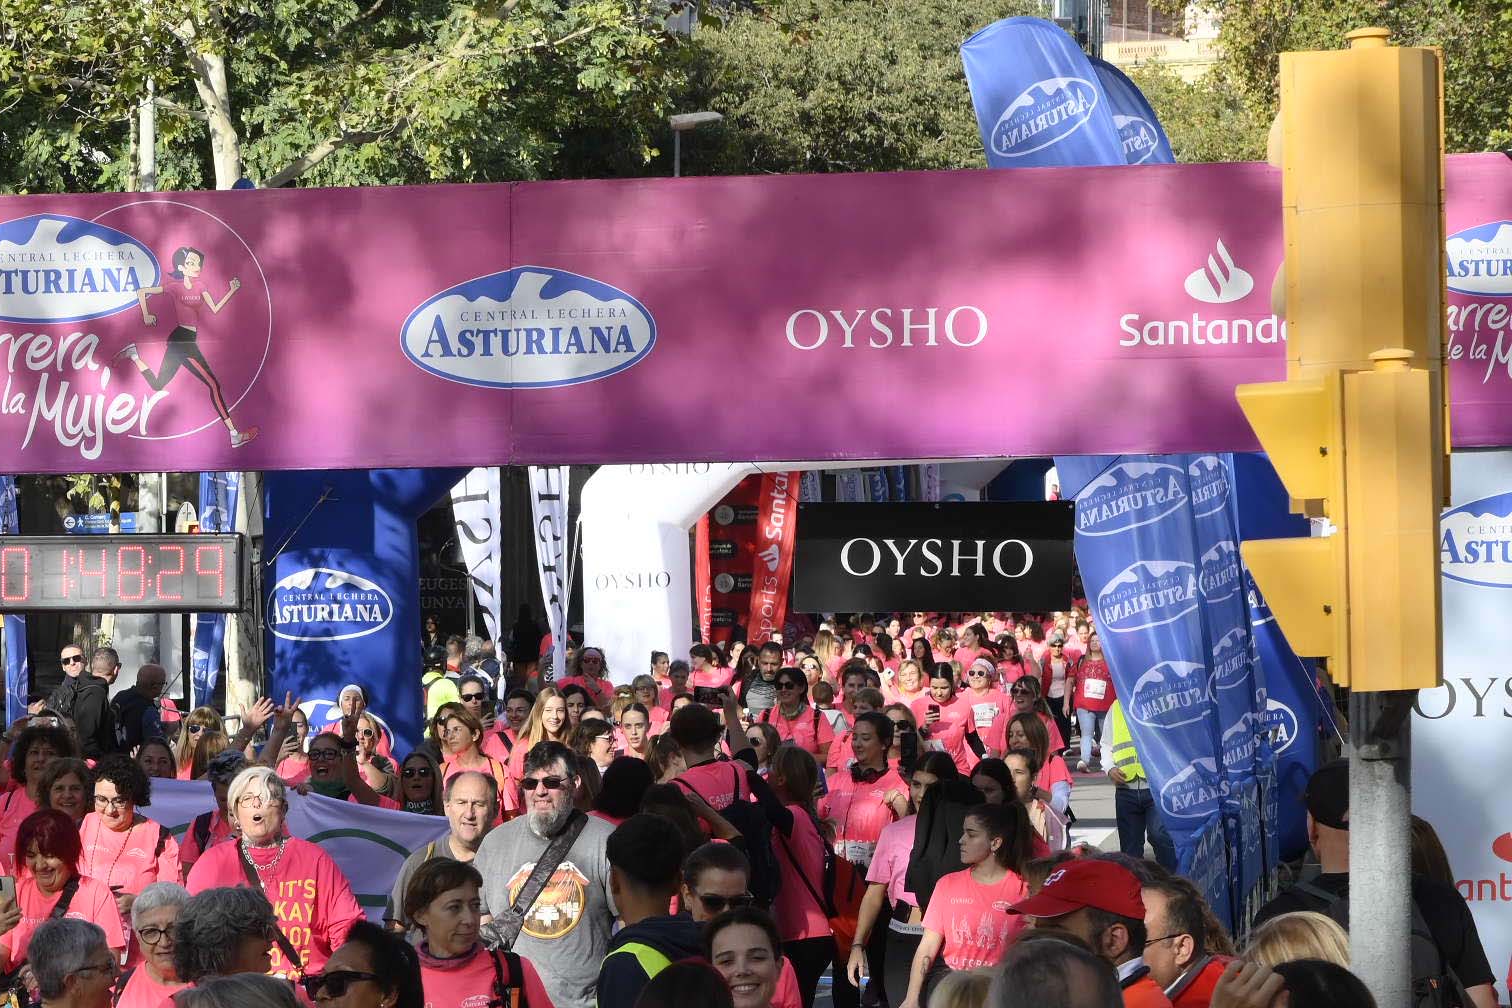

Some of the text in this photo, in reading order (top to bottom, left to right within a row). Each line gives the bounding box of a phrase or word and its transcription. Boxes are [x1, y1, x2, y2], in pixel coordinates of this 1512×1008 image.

[62, 248, 136, 263] LECHERA
[460, 304, 628, 323] CENTRAL LECHERA
[420, 312, 637, 360] ASTURIANA
[785, 305, 989, 351] OYSHO
[1118, 312, 1288, 347] Santand
[0, 377, 27, 416] la
[20, 368, 171, 461] Mujer
[840, 537, 1035, 579] OYSHO
[595, 571, 672, 591] OYSHO
[284, 593, 327, 602] CENTRAL
[271, 598, 384, 626] ASTURIANA
[279, 878, 316, 900] IT'S
